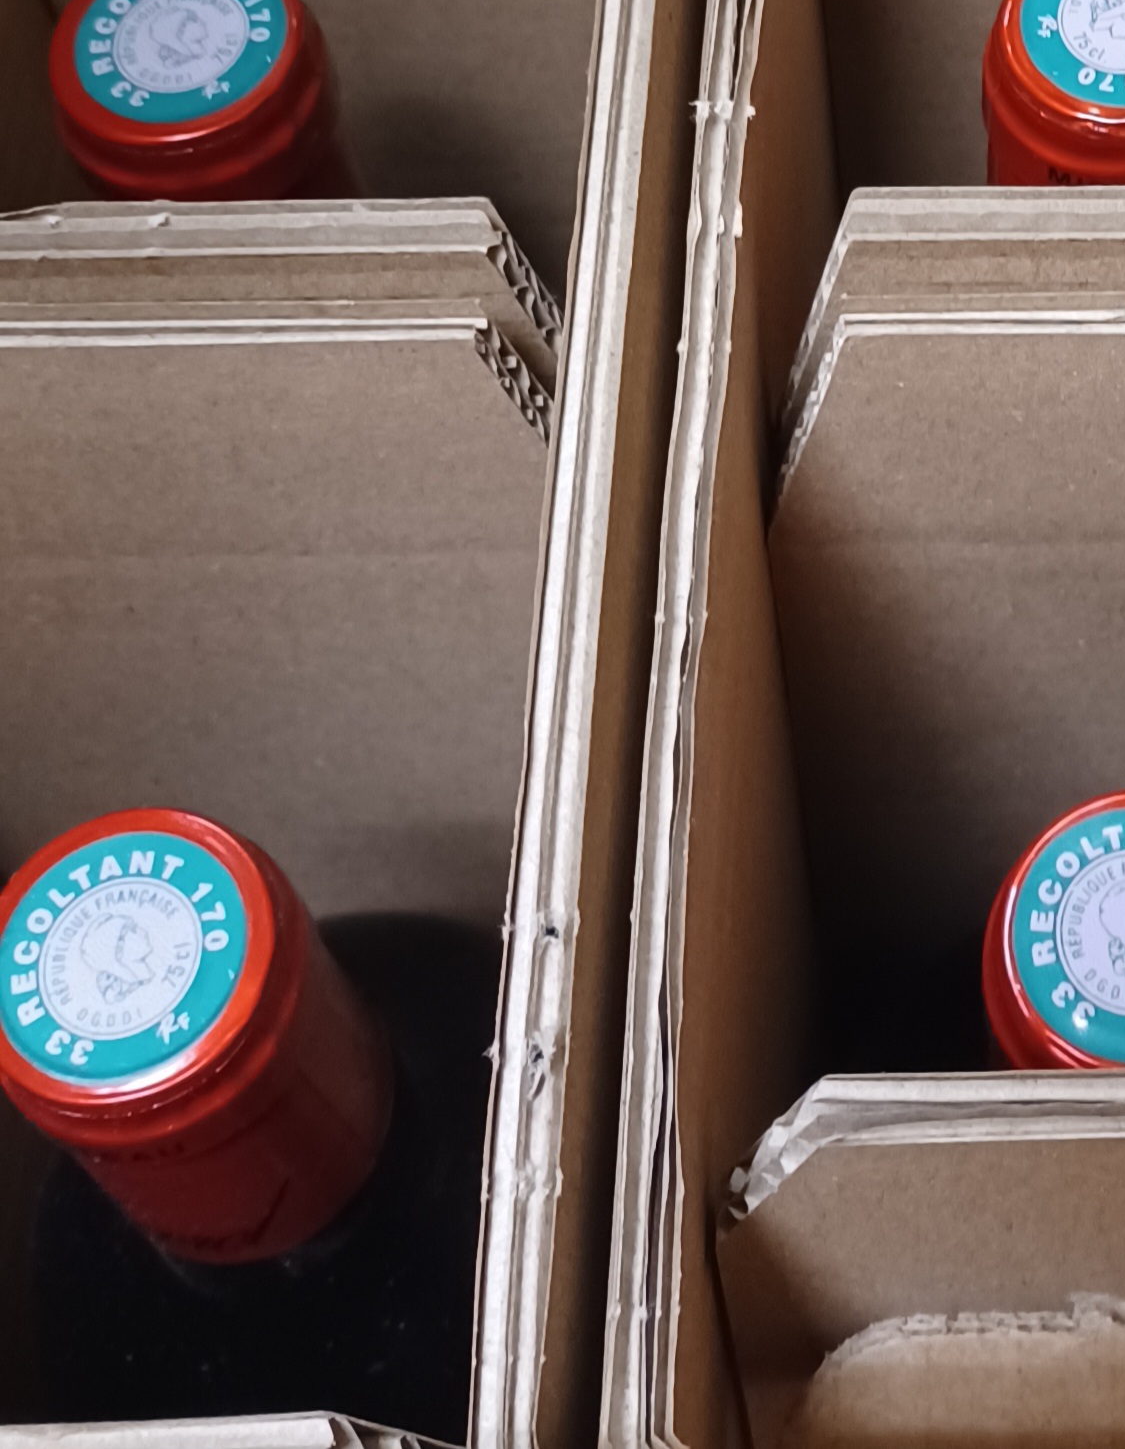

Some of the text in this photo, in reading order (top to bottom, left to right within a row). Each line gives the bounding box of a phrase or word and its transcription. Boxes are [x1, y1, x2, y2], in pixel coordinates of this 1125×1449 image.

[109, 81, 150, 107] 33
[10, 850, 229, 1065] 33 RECOLTANT 170
[1051, 981, 1096, 1030] 33
